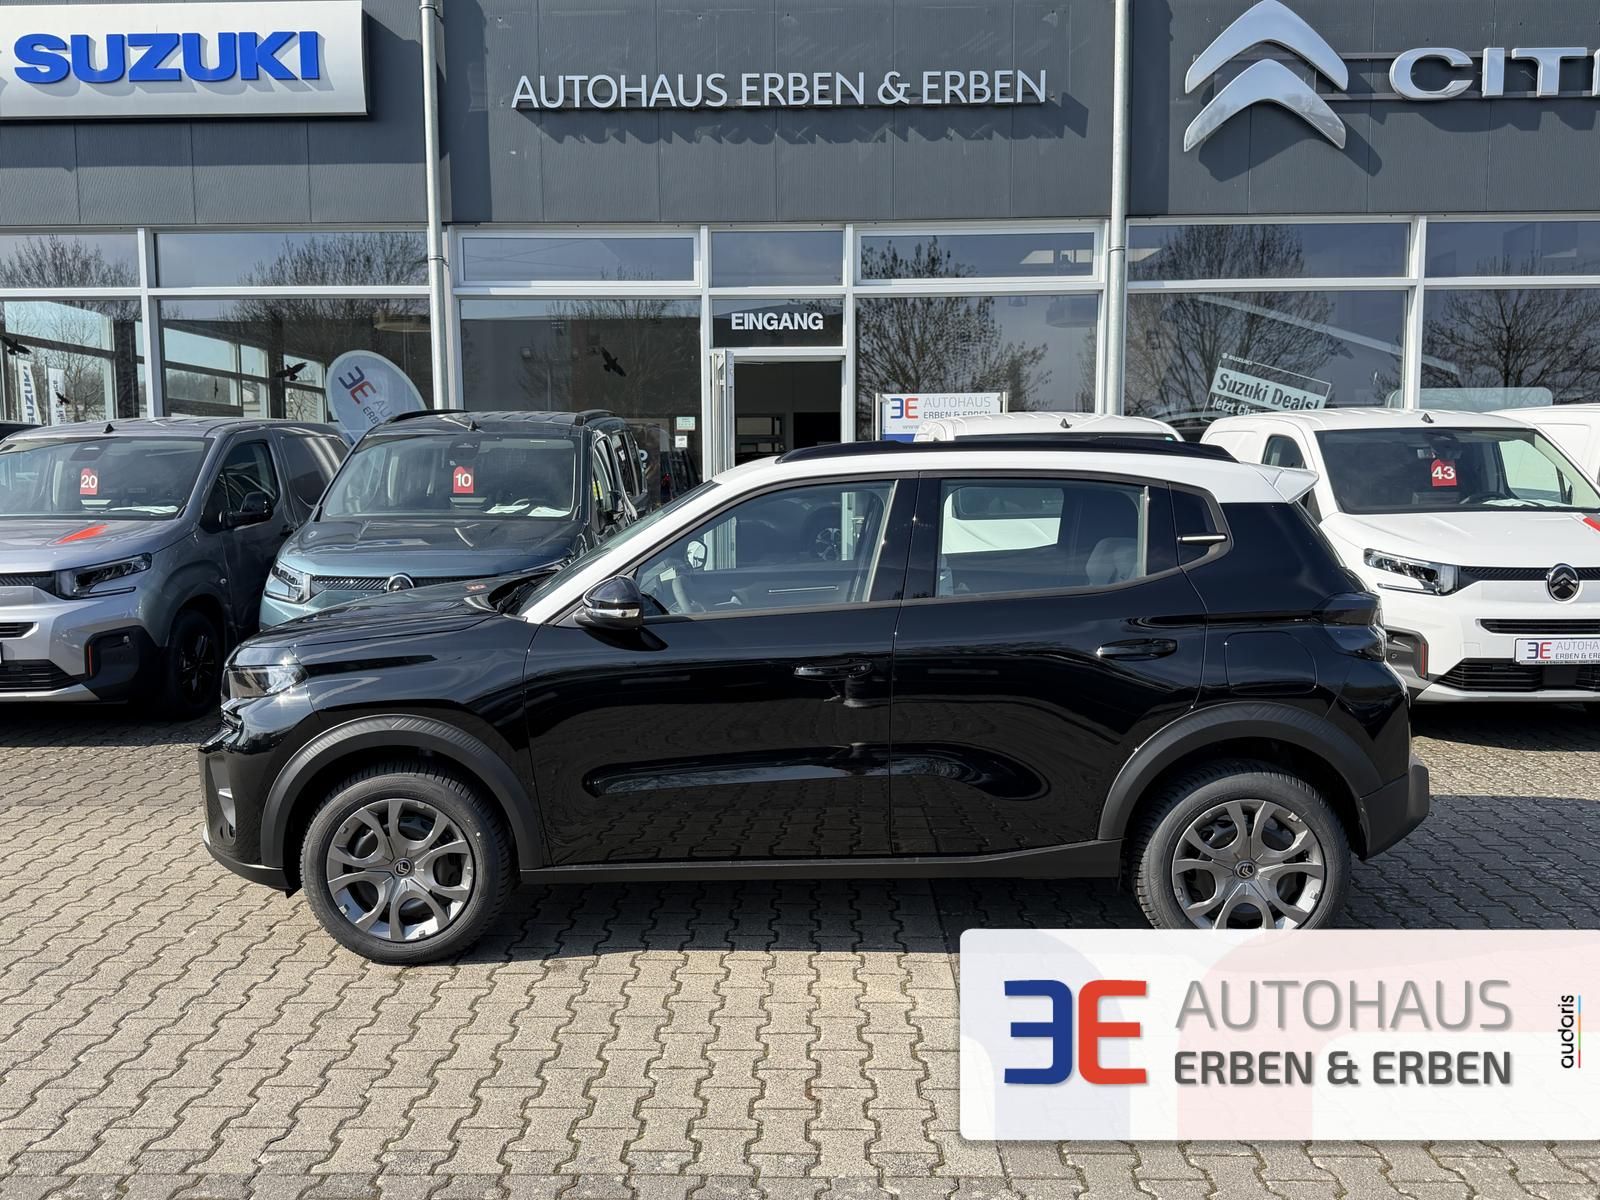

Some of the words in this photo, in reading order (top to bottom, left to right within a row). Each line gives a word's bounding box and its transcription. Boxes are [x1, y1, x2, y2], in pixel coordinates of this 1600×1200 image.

[14, 31, 320, 84] SUZUKI
[1388, 46, 1600, 100] CIT
[511, 73, 729, 109] AUTOHAUS
[741, 71, 865, 107] ERBEN
[877, 71, 910, 105] &
[922, 69, 1047, 104] ERBEN
[731, 312, 824, 331] EINGANG
[1217, 373, 1269, 402] Suzuki
[923, 396, 991, 408] AUTOHAUS
[1210, 397, 1236, 413] Jetzt
[1237, 404, 1261, 416] Cha
[923, 411, 952, 419] ERBEN
[455, 473, 472, 487] 10
[1431, 465, 1456, 480] 43
[80, 474, 98, 489] 20
[1555, 652, 1579, 660] ERBEN
